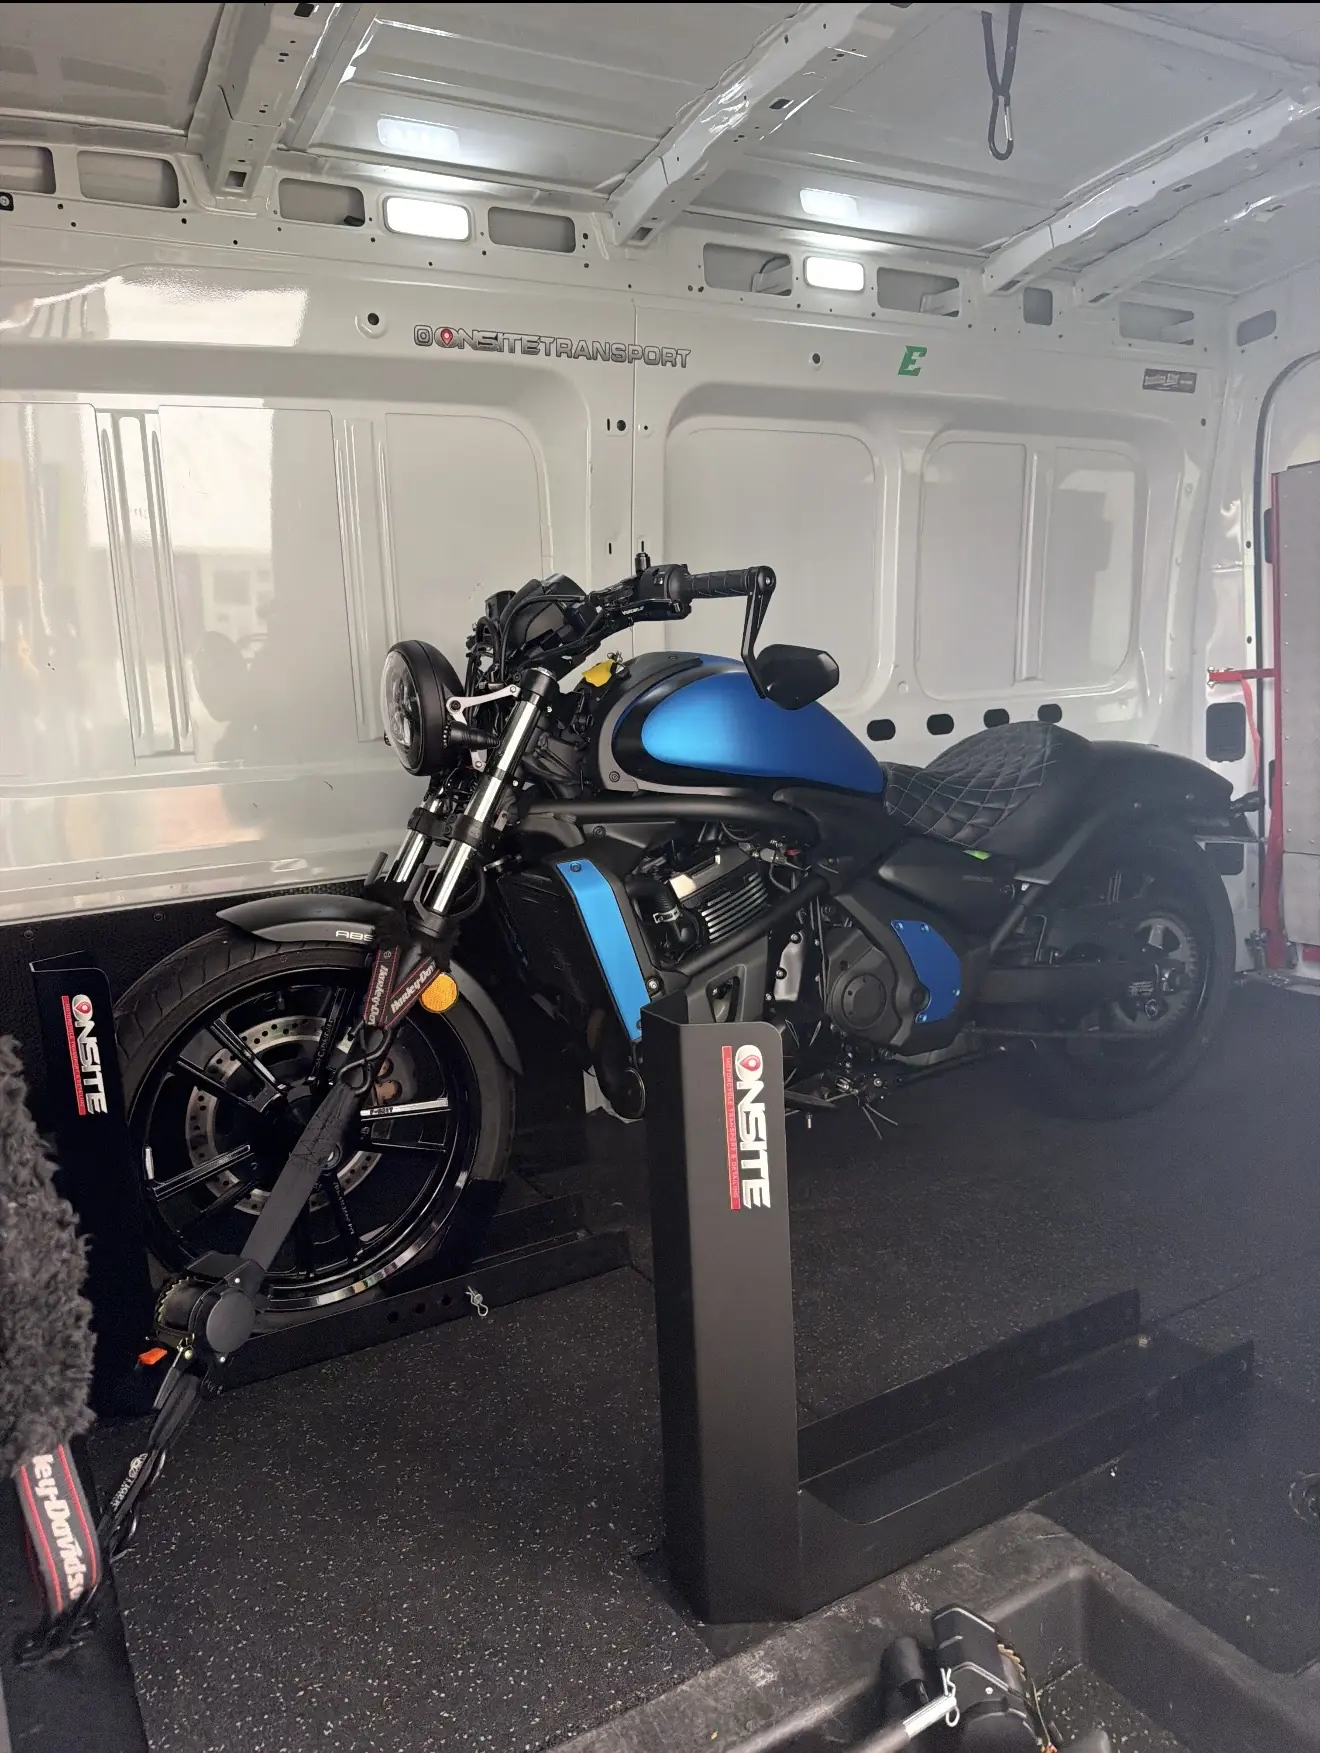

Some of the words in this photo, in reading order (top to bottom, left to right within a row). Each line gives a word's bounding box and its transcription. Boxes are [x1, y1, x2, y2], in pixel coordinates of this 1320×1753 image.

[71, 994, 108, 1115] ONSITE
[725, 1057, 733, 1104] MOTORCYCLE
[728, 1109, 737, 1150] TRANSPORT
[735, 1044, 771, 1210] ONSITE
[731, 1161, 739, 1198] DETAILING
